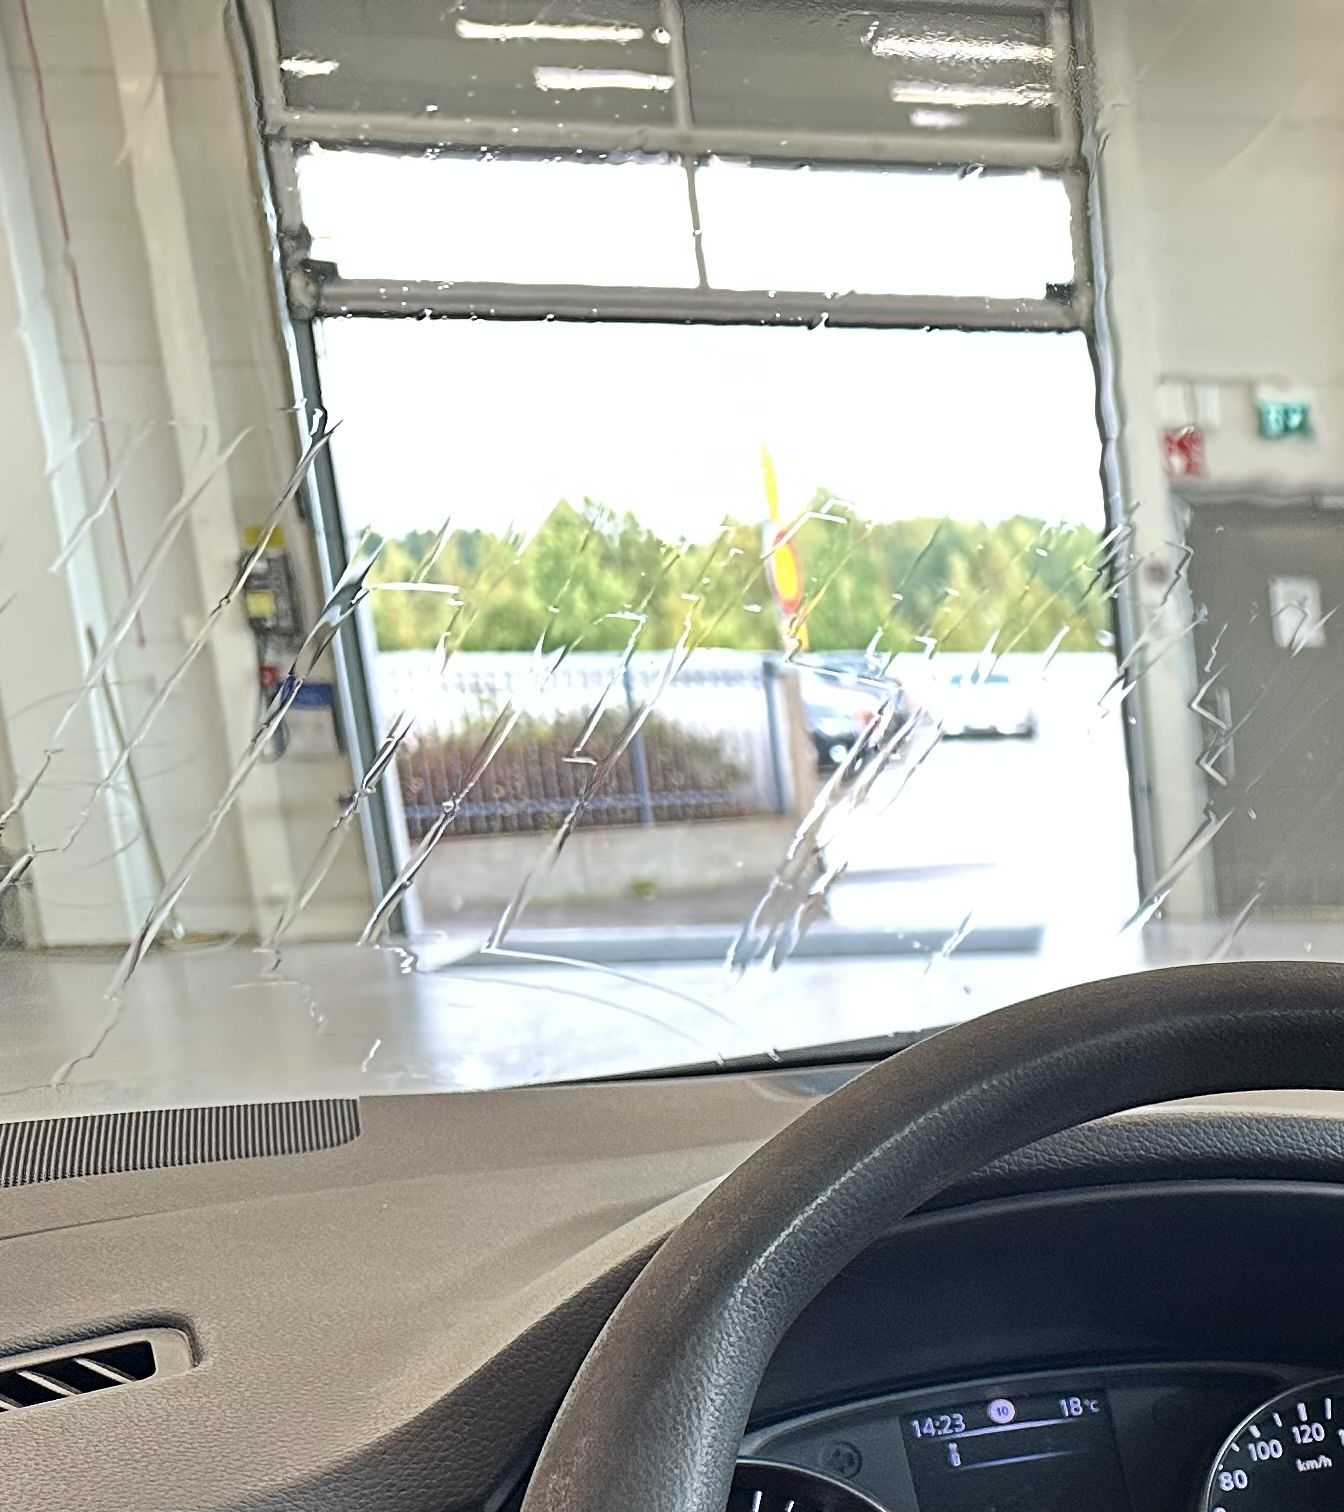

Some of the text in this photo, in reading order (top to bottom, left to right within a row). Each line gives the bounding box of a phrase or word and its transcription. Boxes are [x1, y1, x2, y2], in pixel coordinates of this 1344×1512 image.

[910, 1412, 966, 1439] 14:23
[1292, 1422, 1325, 1444] 120
[1249, 1439, 1283, 1462] 100
[1296, 1454, 1332, 1472] km/h
[1218, 1469, 1248, 1492] 80
